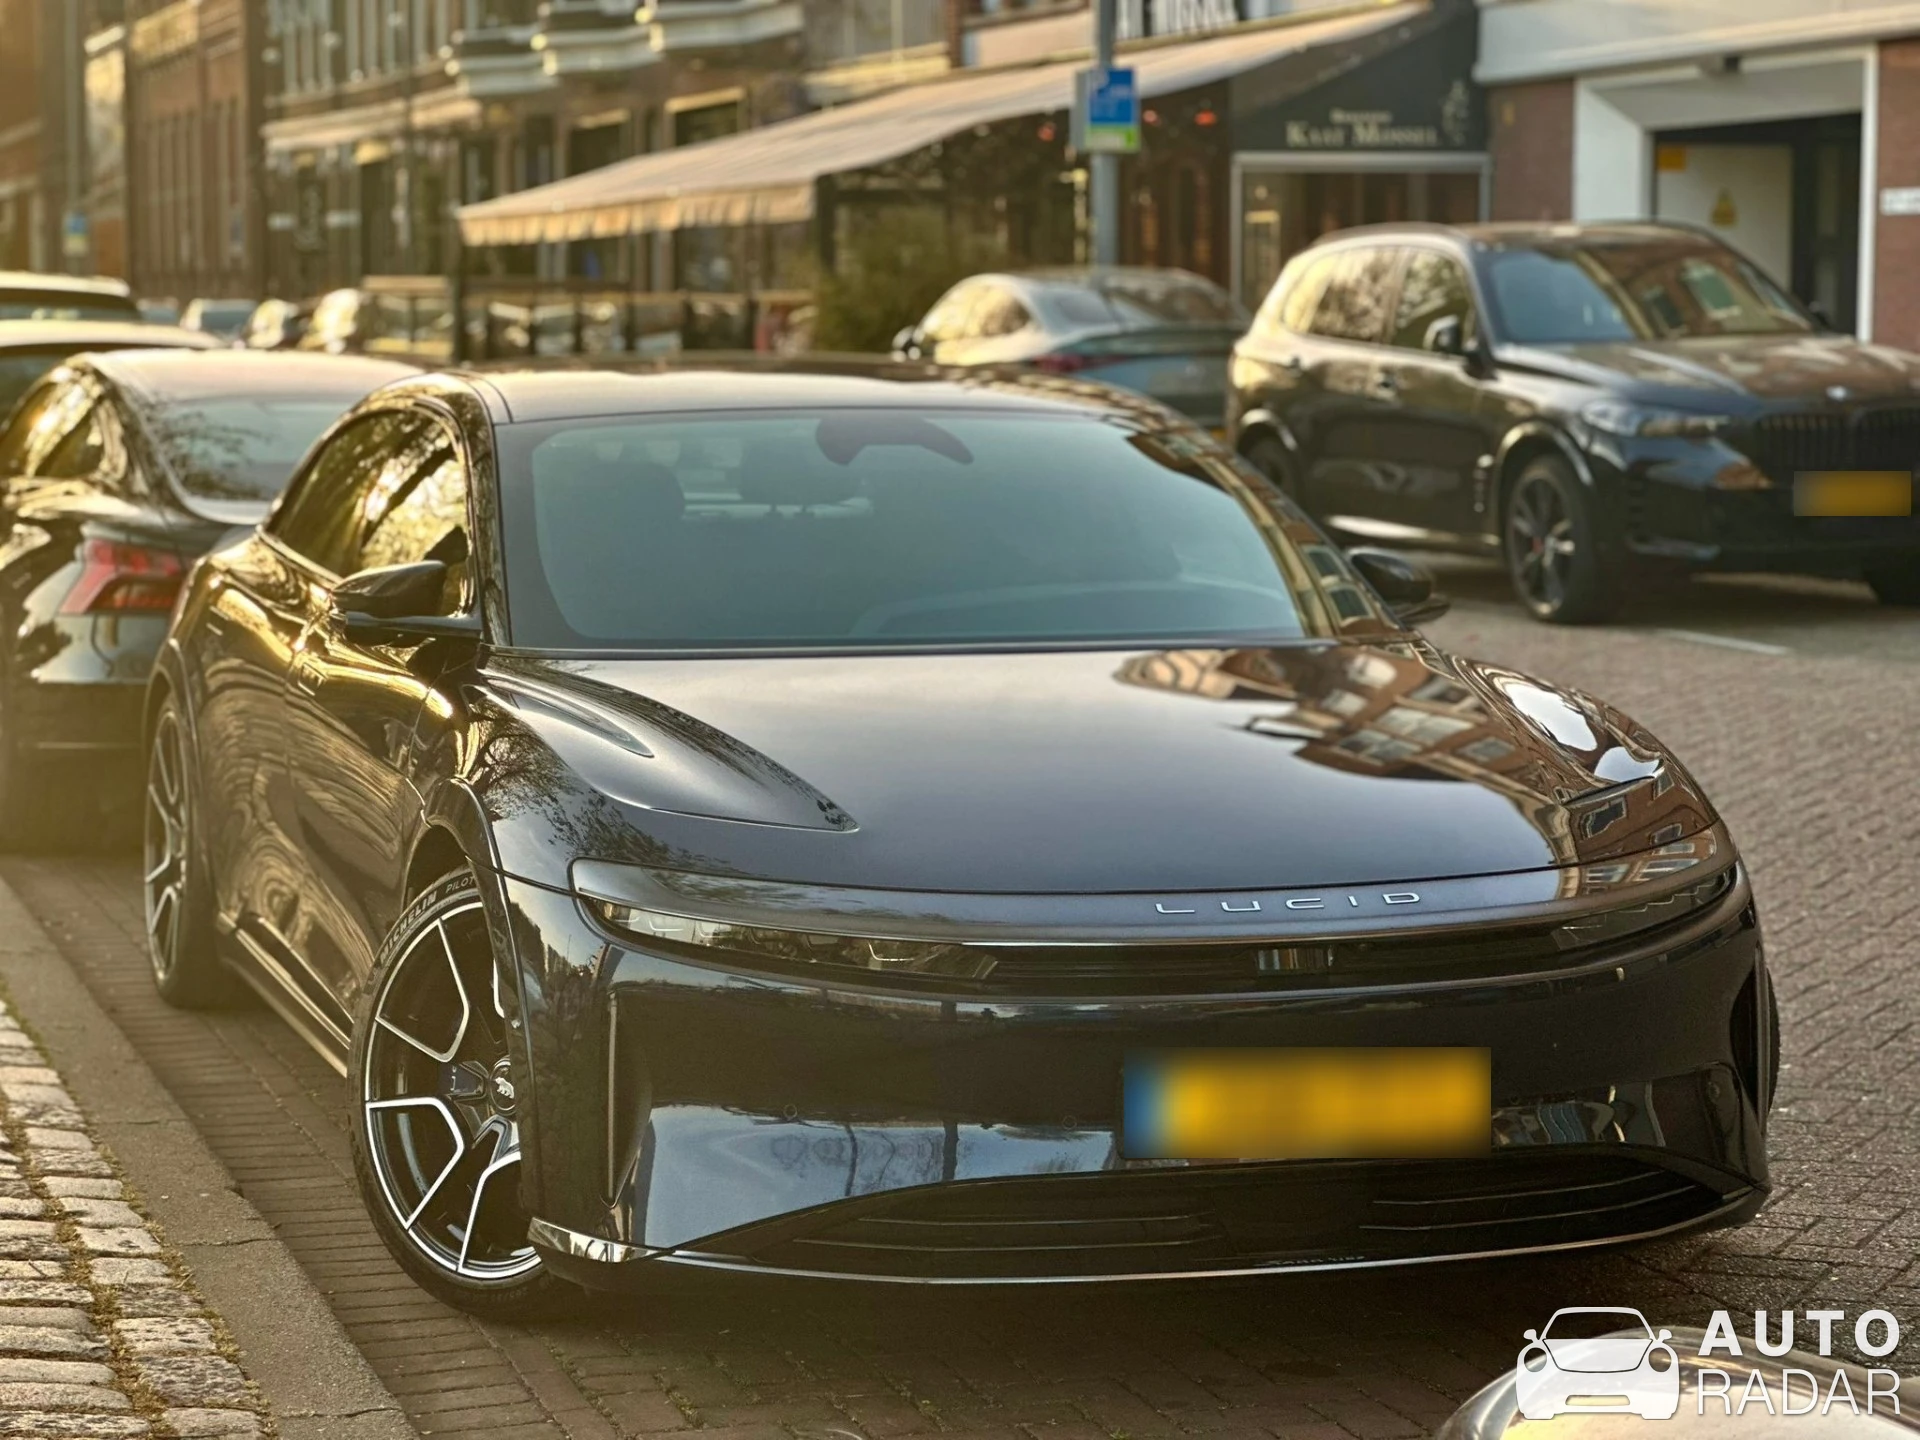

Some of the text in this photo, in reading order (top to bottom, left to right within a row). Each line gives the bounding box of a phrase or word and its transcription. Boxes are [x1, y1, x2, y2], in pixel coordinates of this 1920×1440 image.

[379, 876, 475, 964] MICHELIN PILOT
[1155, 892, 1420, 914] LUCID
